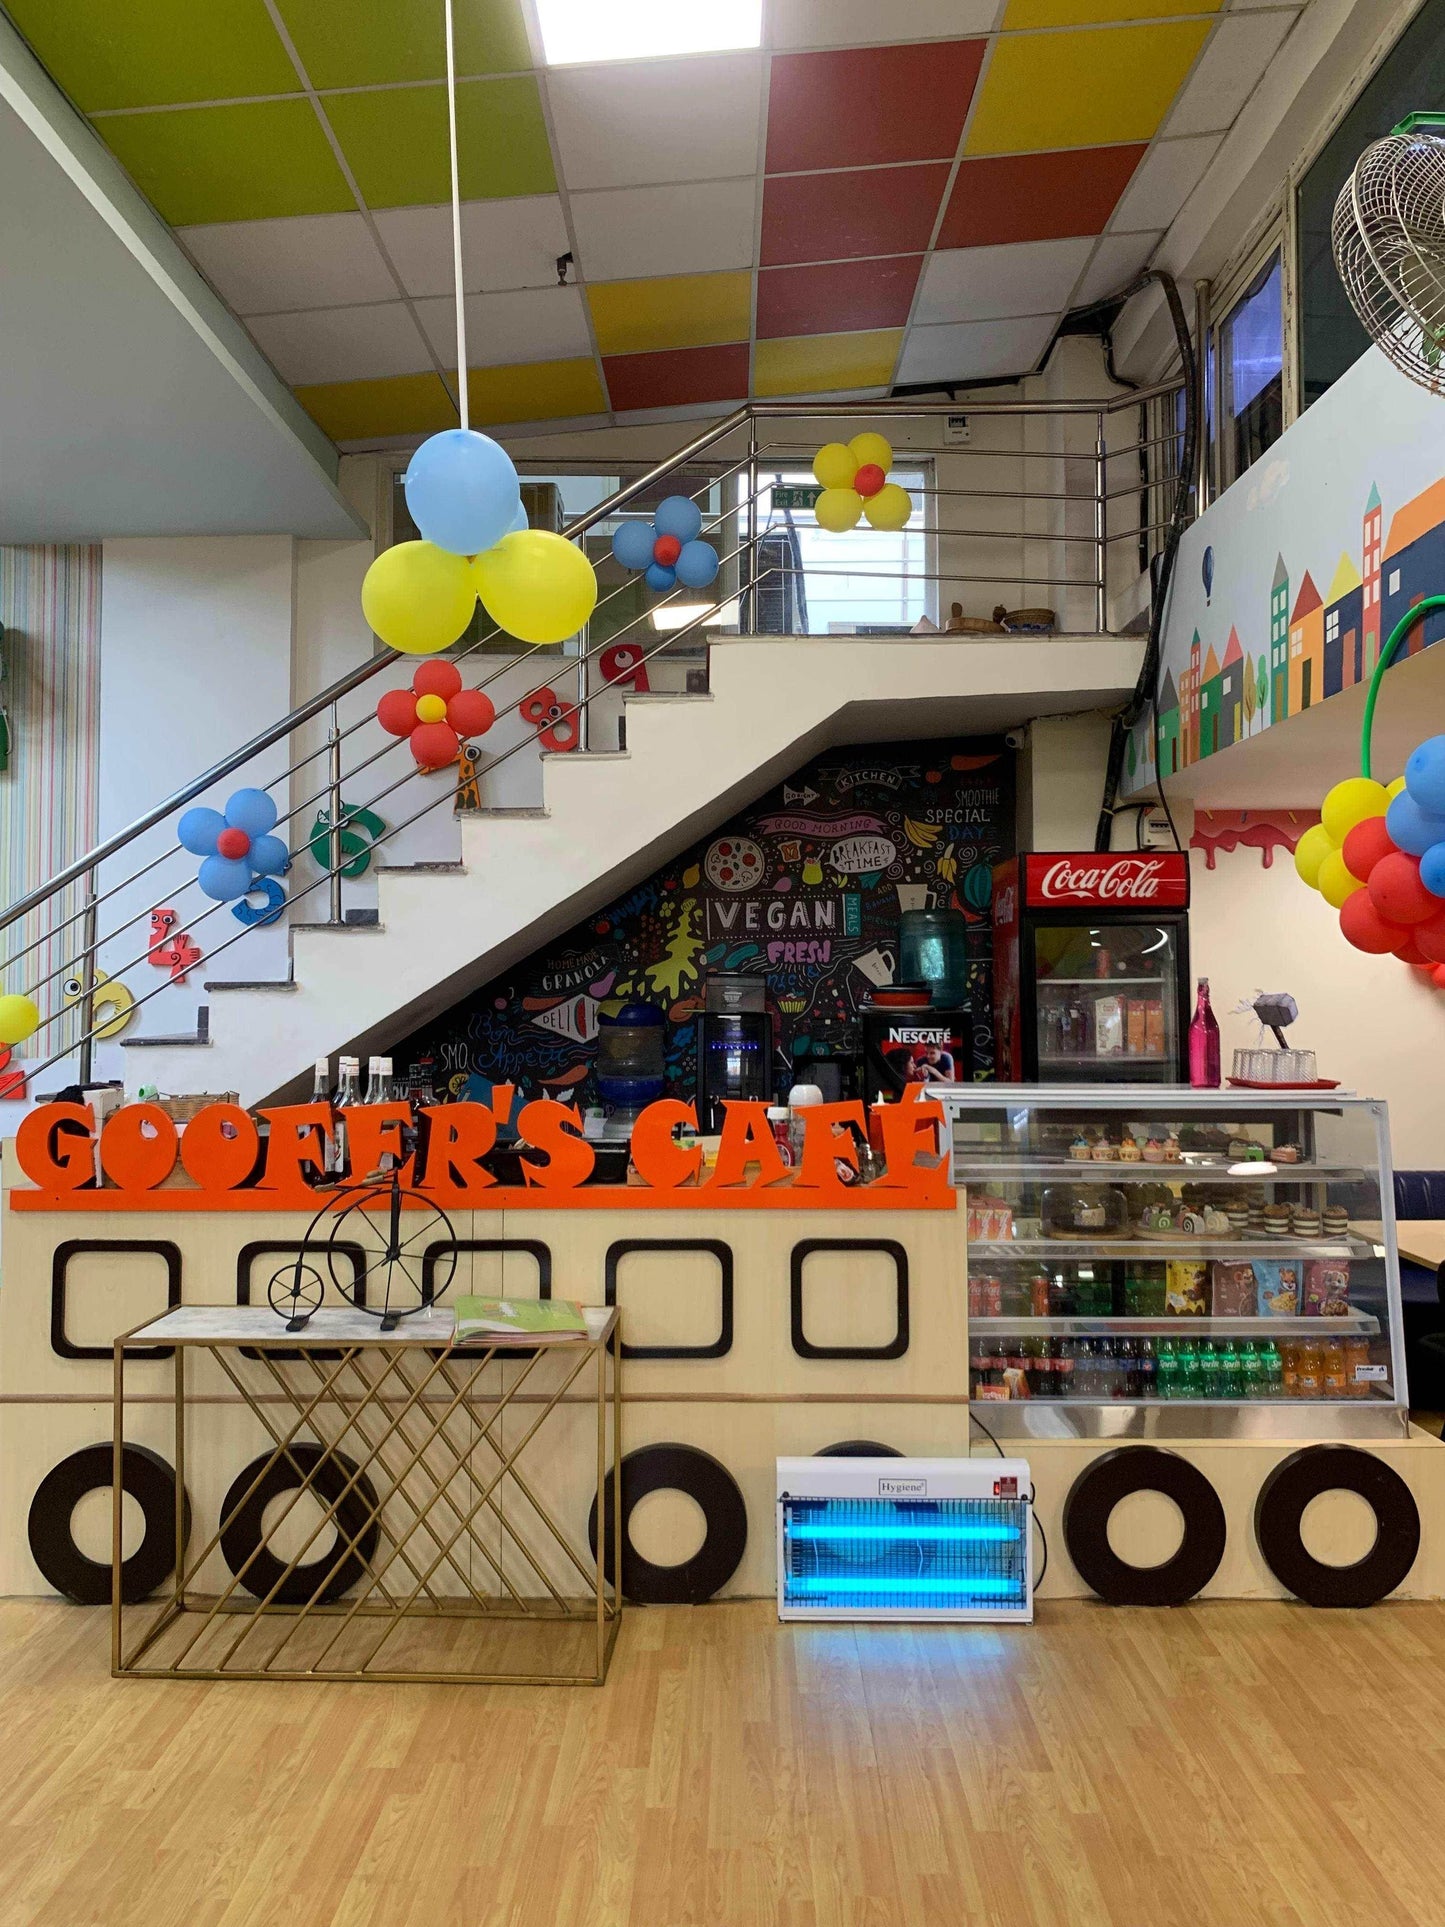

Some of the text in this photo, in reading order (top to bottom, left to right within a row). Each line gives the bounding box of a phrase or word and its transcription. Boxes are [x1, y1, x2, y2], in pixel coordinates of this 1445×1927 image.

[775, 490, 788, 498] Fire
[775, 499, 788, 507] Exit
[841, 770, 896, 788] KITCHEN
[955, 787, 1000, 808] SMOOTHIE
[774, 817, 872, 834] GOOD MORNING
[925, 809, 991, 824] SPECIAL
[948, 825, 986, 841] DAY
[833, 841, 892, 861] BREAKFAST
[844, 856, 884, 870] TIME
[1041, 859, 1166, 900] Coca-Cola
[714, 896, 859, 933] VEGAN MEALS
[767, 939, 832, 964] FRESH
[542, 954, 610, 992] GRANOLA
[888, 1026, 951, 1044] NESCAFÉ
[16, 1082, 951, 1190] GOOFER'S CAFÉ
